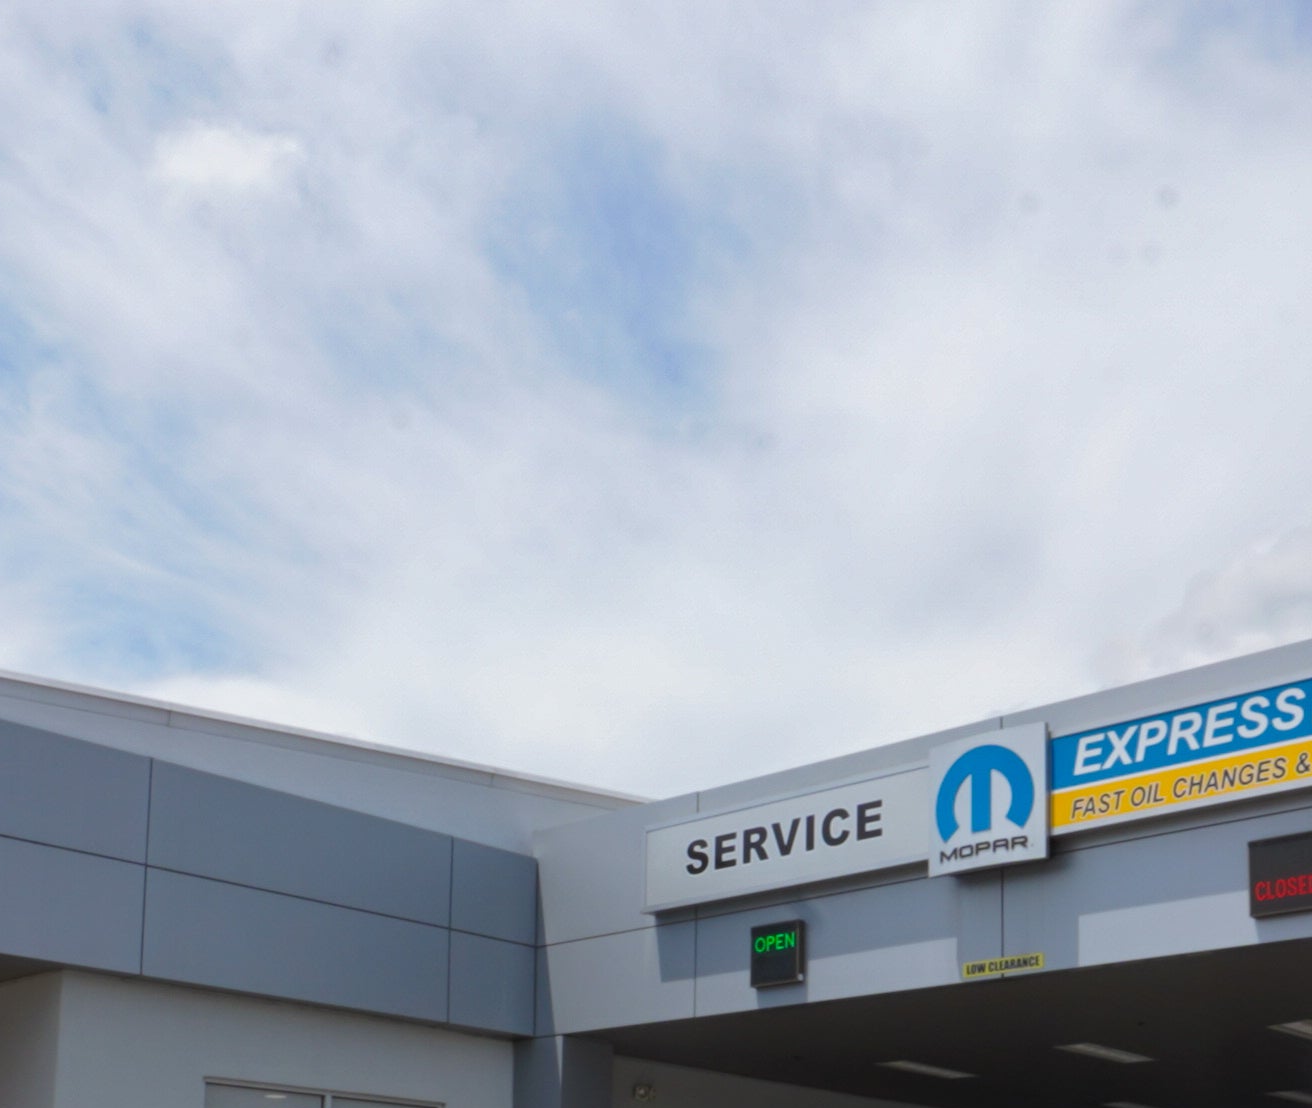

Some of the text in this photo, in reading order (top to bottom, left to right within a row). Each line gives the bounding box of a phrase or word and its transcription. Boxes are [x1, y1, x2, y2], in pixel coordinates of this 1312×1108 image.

[1073, 688, 1306, 775] EXPRESS
[1070, 789, 1127, 820] FAST
[1130, 782, 1164, 808] OIL
[1172, 755, 1287, 798] CHANGES
[1296, 752, 1312, 774] &
[686, 799, 884, 875] SERVICE
[940, 835, 1029, 864] MOPAR
[754, 931, 795, 953] OPEN
[966, 955, 1040, 975] LOW CLEARANCE
